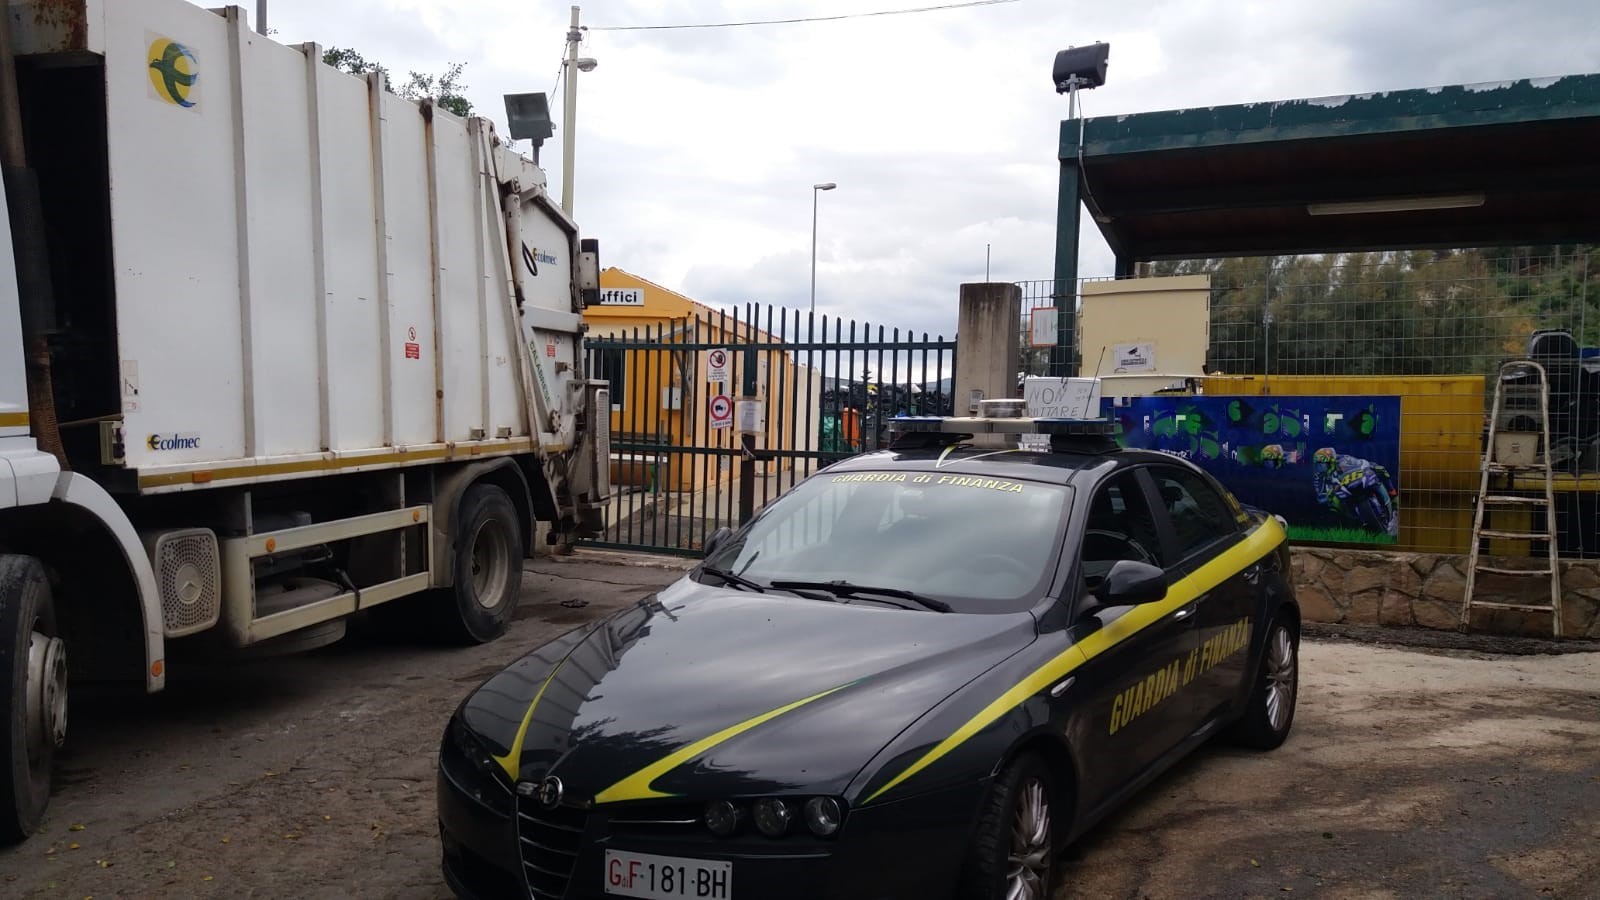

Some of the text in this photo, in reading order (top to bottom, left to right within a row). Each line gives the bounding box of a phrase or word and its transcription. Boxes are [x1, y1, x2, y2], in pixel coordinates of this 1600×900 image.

[532, 247, 558, 265] Ecolmec
[1029, 387, 1068, 404] NON
[147, 433, 201, 451] Ecolmec
[832, 474, 1025, 493] GUARDIA di FINANZA
[1341, 469, 1363, 486] 46
[1109, 616, 1249, 736] GUARDIA di FINANZA
